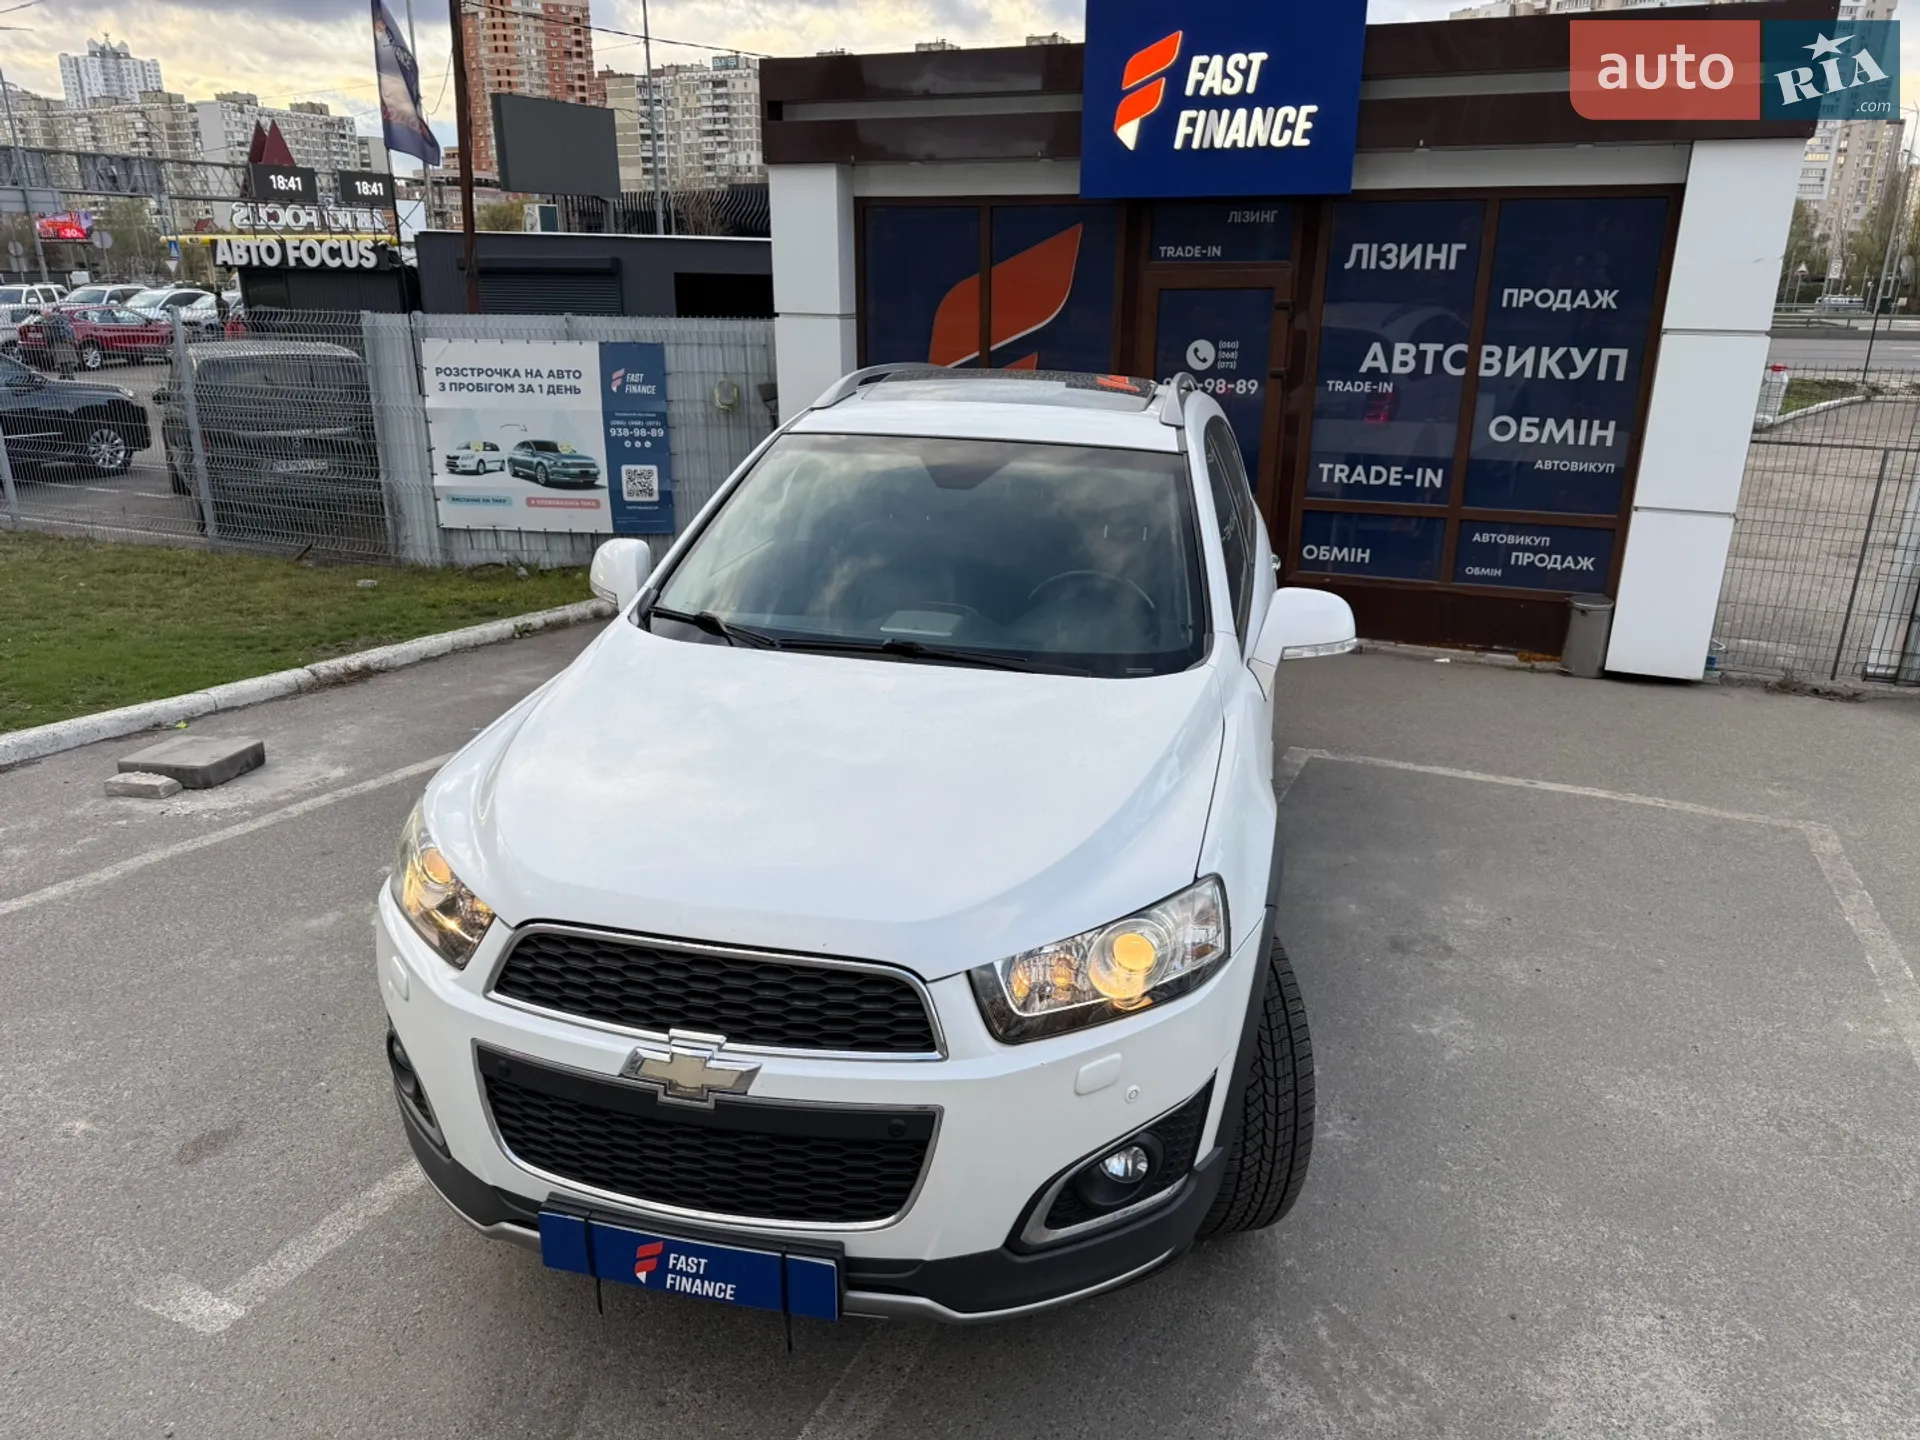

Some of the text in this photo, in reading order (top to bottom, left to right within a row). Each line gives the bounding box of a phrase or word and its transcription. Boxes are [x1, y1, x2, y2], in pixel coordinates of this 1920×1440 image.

[1185, 52, 1268, 96] FAST
[1173, 105, 1318, 150] FINANCE
[269, 174, 303, 191] 18:41
[355, 181, 384, 196] 18:41
[1228, 210, 1278, 223] ЛІЗИНГ
[215, 239, 378, 268] АВТО FOCUS
[1159, 246, 1222, 257] TRADE-IN
[1344, 243, 1467, 270] ЛІЗИНГ
[1502, 288, 1620, 311] ПРОДАЖ
[435, 367, 582, 379] РОЗСТРОЧКА НА АВТО
[626, 373, 644, 383] FAST
[450, 382, 515, 393] ПРОБІГОМ
[519, 384, 535, 393] ЗА
[538, 384, 544, 394] 1
[546, 385, 581, 395] ДЕНЬ
[625, 384, 657, 395] FINANCE
[1327, 380, 1394, 393] TRADE-IN
[610, 428, 664, 437] 938-98-89
[1488, 416, 1616, 447] ОБМІН
[1534, 460, 1615, 474] АВТОВИКУП
[1319, 463, 1443, 488] TRADE-IN
[1472, 532, 1550, 547] АВТОВИКУП
[1303, 545, 1370, 563] ОБМІН
[1510, 552, 1595, 571] ПРОДАЖ
[1465, 566, 1502, 577] ОБМІН
[668, 1253, 708, 1275] FAST
[666, 1274, 736, 1300] FINANCE
